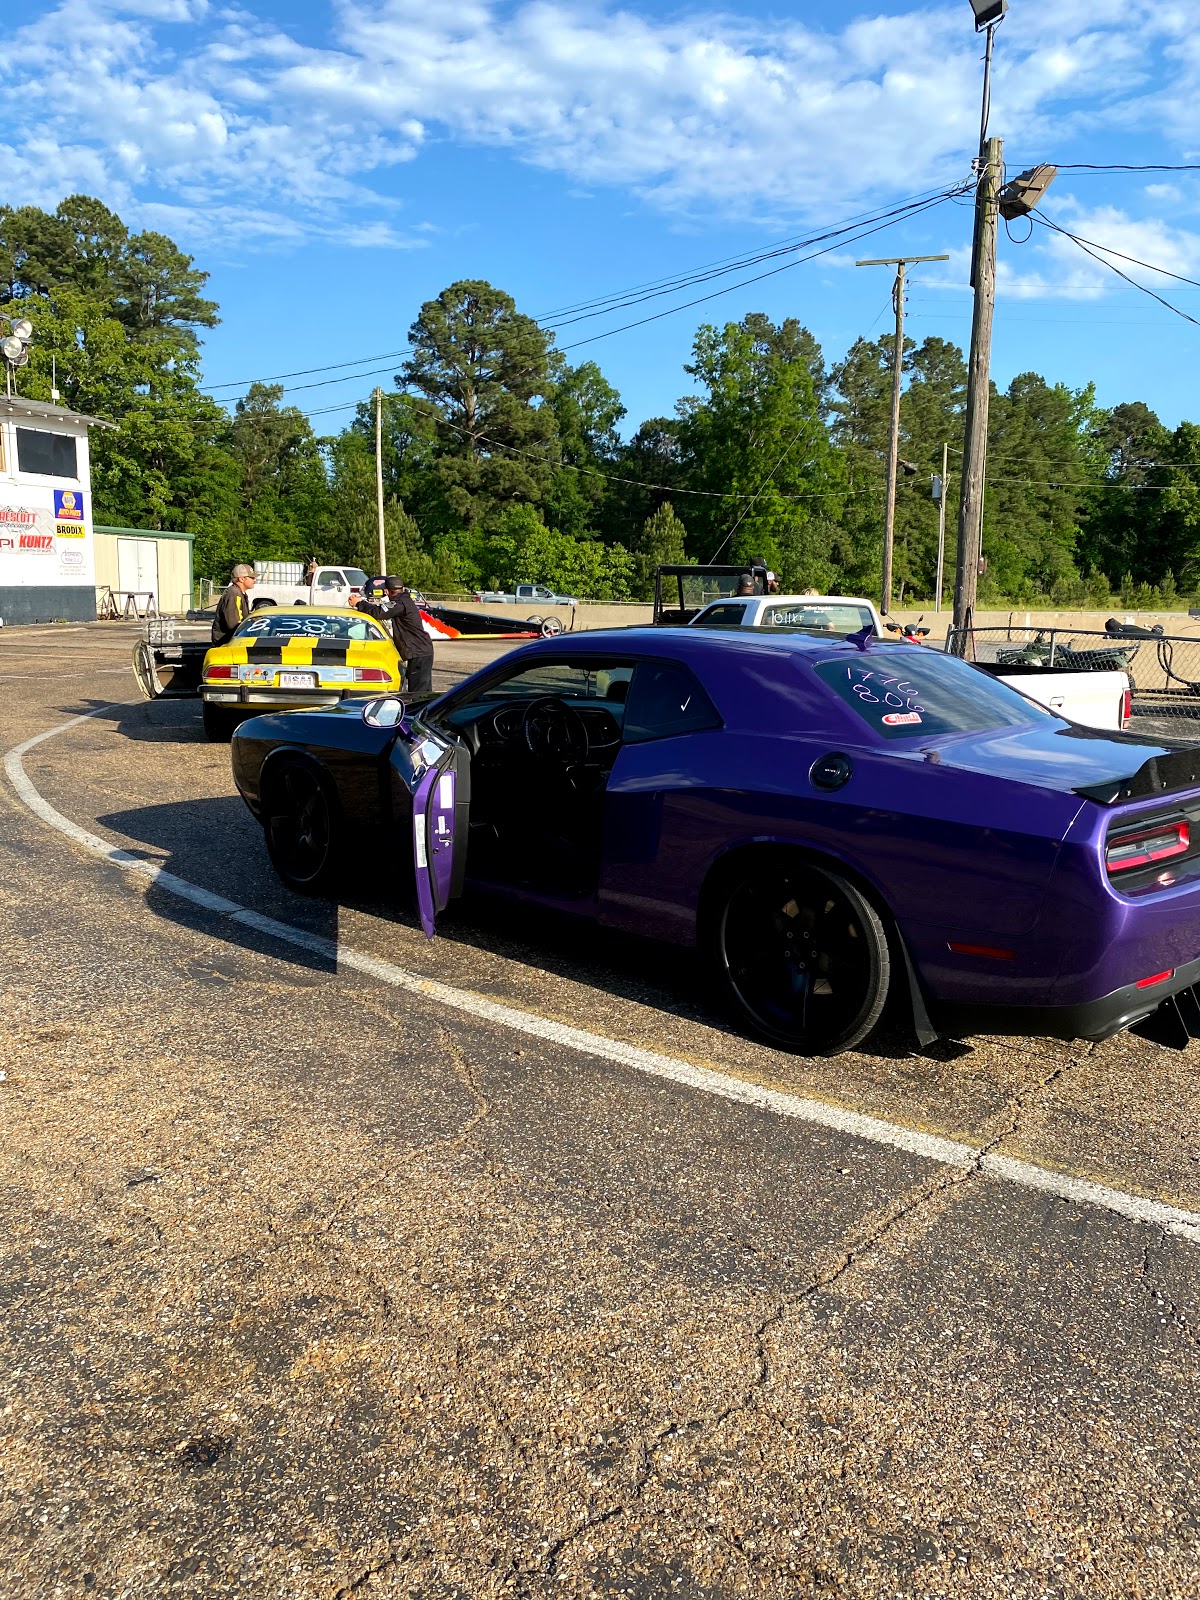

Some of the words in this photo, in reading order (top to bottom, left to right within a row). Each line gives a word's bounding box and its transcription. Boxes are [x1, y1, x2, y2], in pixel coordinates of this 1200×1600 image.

[56, 525, 83, 535] BRODIX
[19, 535, 53, 549] KUNTZ
[847, 667, 919, 696] 1776
[852, 683, 926, 713] 8.06
